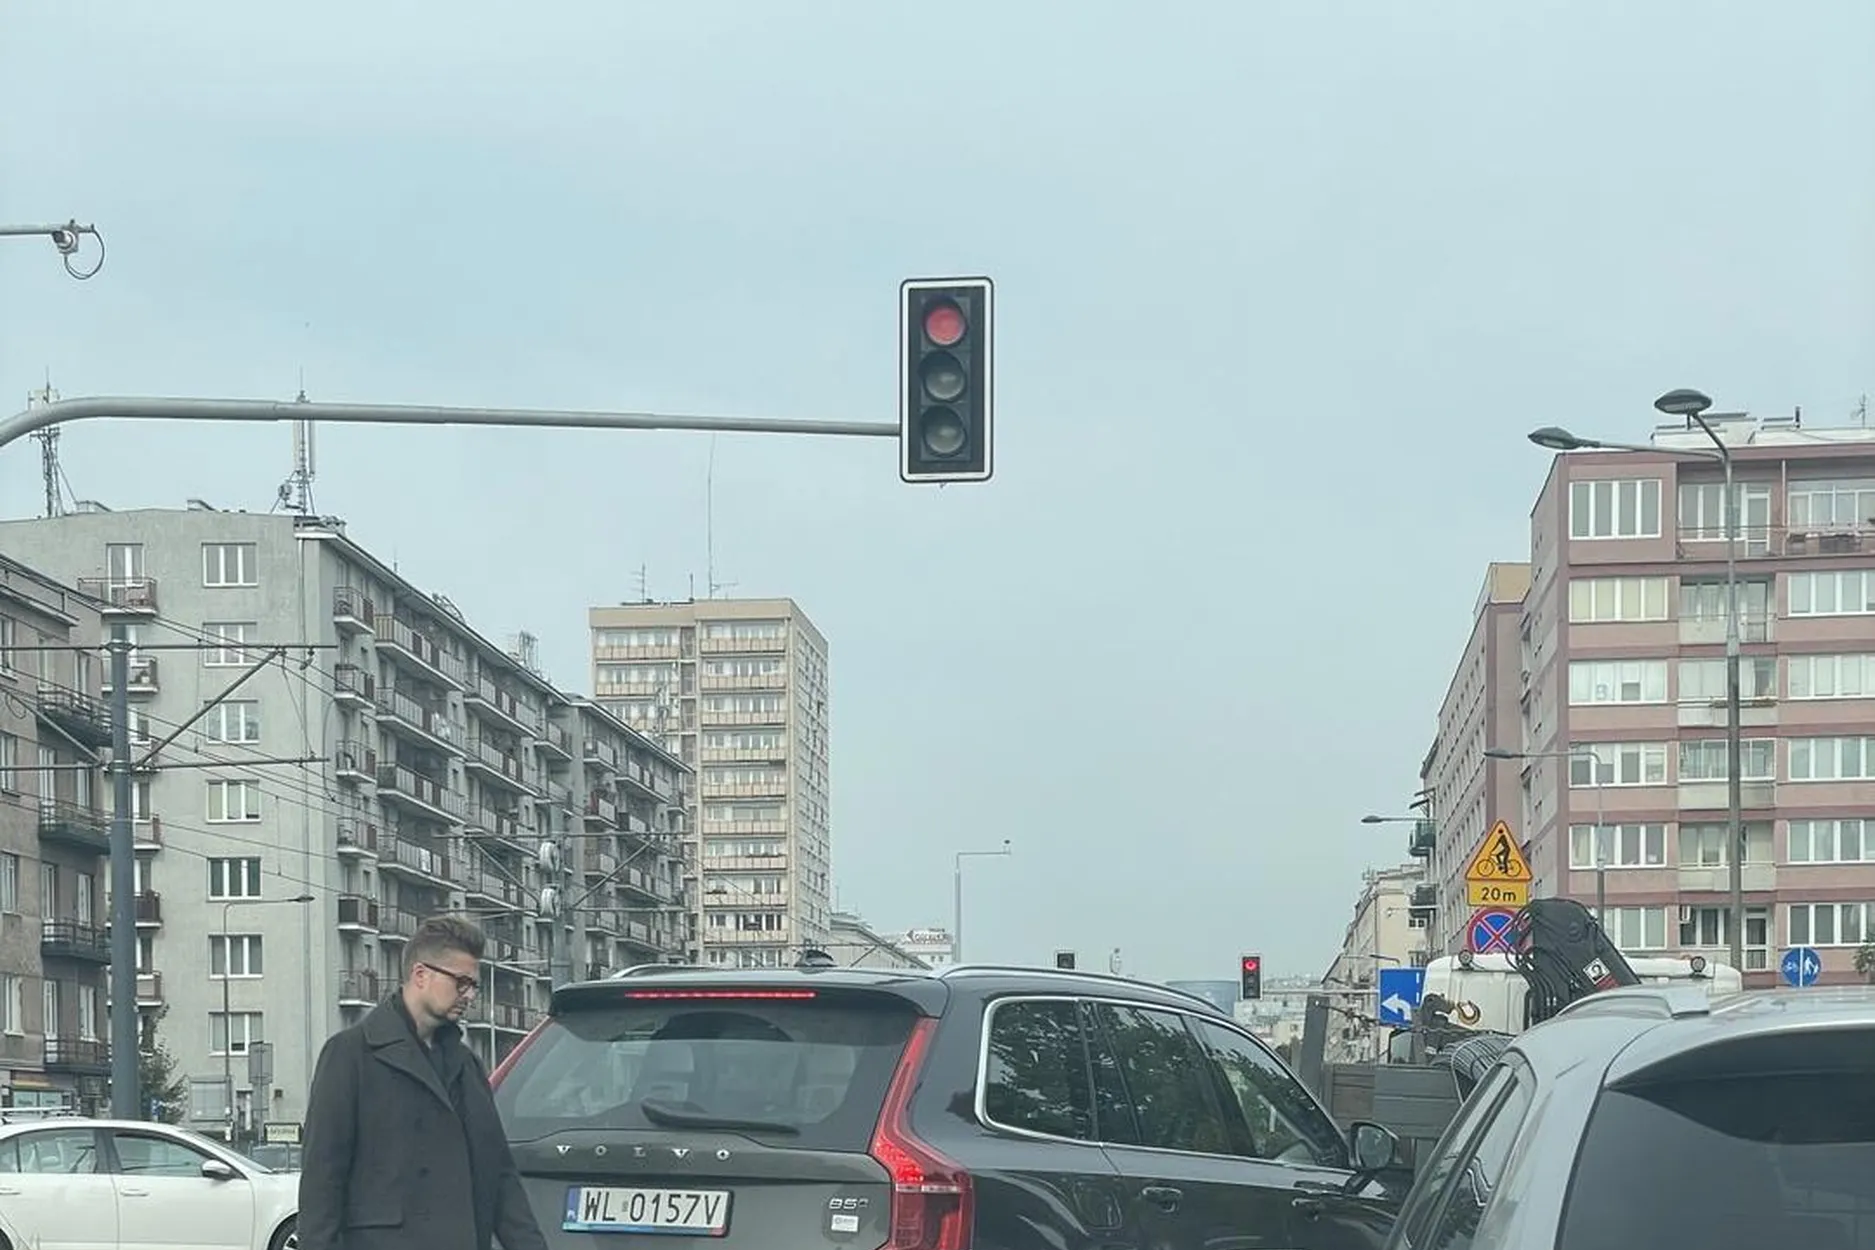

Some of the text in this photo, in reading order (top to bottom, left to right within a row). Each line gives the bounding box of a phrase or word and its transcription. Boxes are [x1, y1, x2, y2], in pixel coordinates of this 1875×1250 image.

[556, 1144, 730, 1161] VOLVO
[583, 1191, 722, 1226] WL 0157V
